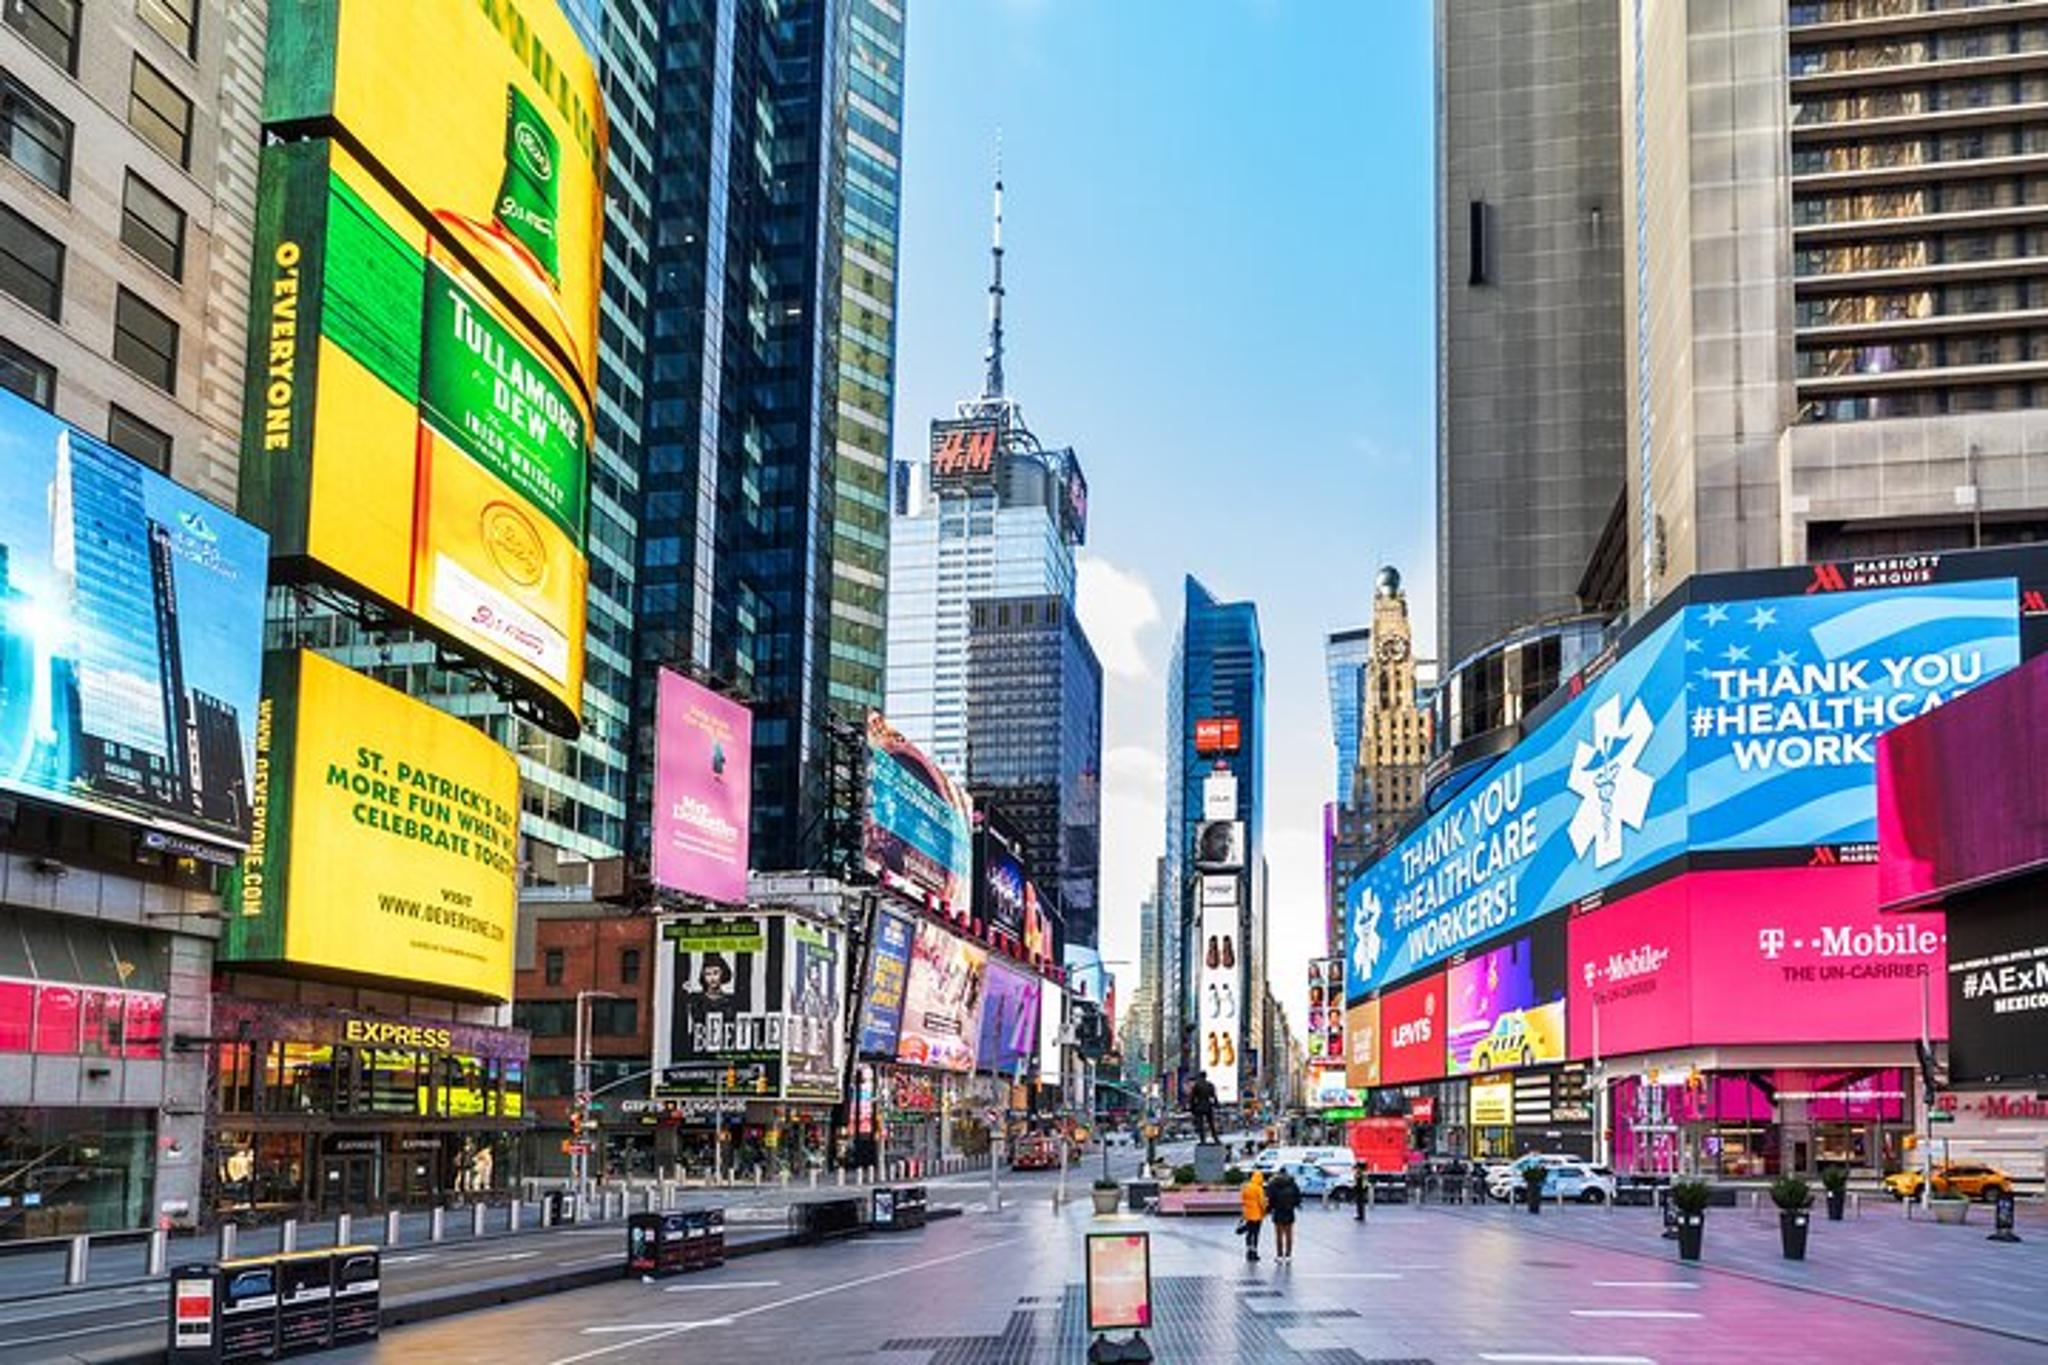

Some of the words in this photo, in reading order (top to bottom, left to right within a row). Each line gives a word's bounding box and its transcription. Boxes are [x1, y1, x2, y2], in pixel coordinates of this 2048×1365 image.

[265, 241, 300, 450] O'EVERYONE
[448, 288, 579, 450] TULLAMORE
[494, 377, 548, 446] DEW
[935, 428, 997, 475] H&M
[1853, 556, 1941, 573] MARRIOTT
[1853, 569, 1932, 587] MARQUIS
[1711, 658, 1871, 702] THANK
[1880, 649, 1982, 687] YOU
[1691, 690, 1970, 739] #HEALTHCA
[1732, 733, 1884, 773] WORK
[326, 763, 399, 809] MORE
[408, 792, 451, 826] FUN
[457, 813, 499, 850] WHEN
[355, 745, 389, 777] ST.
[397, 760, 492, 818] PATRICK'S
[351, 803, 469, 858] CELEBRATE
[1401, 810, 1466, 886] THANK
[1470, 762, 1523, 834] YOU
[1393, 806, 1538, 931] #HEALTHCARE
[1407, 875, 1518, 964] WORKERS!
[1782, 966, 1815, 982] THE
[1819, 964, 1931, 980] UN-CARRIER
[346, 1019, 450, 1049] EXPRESS
